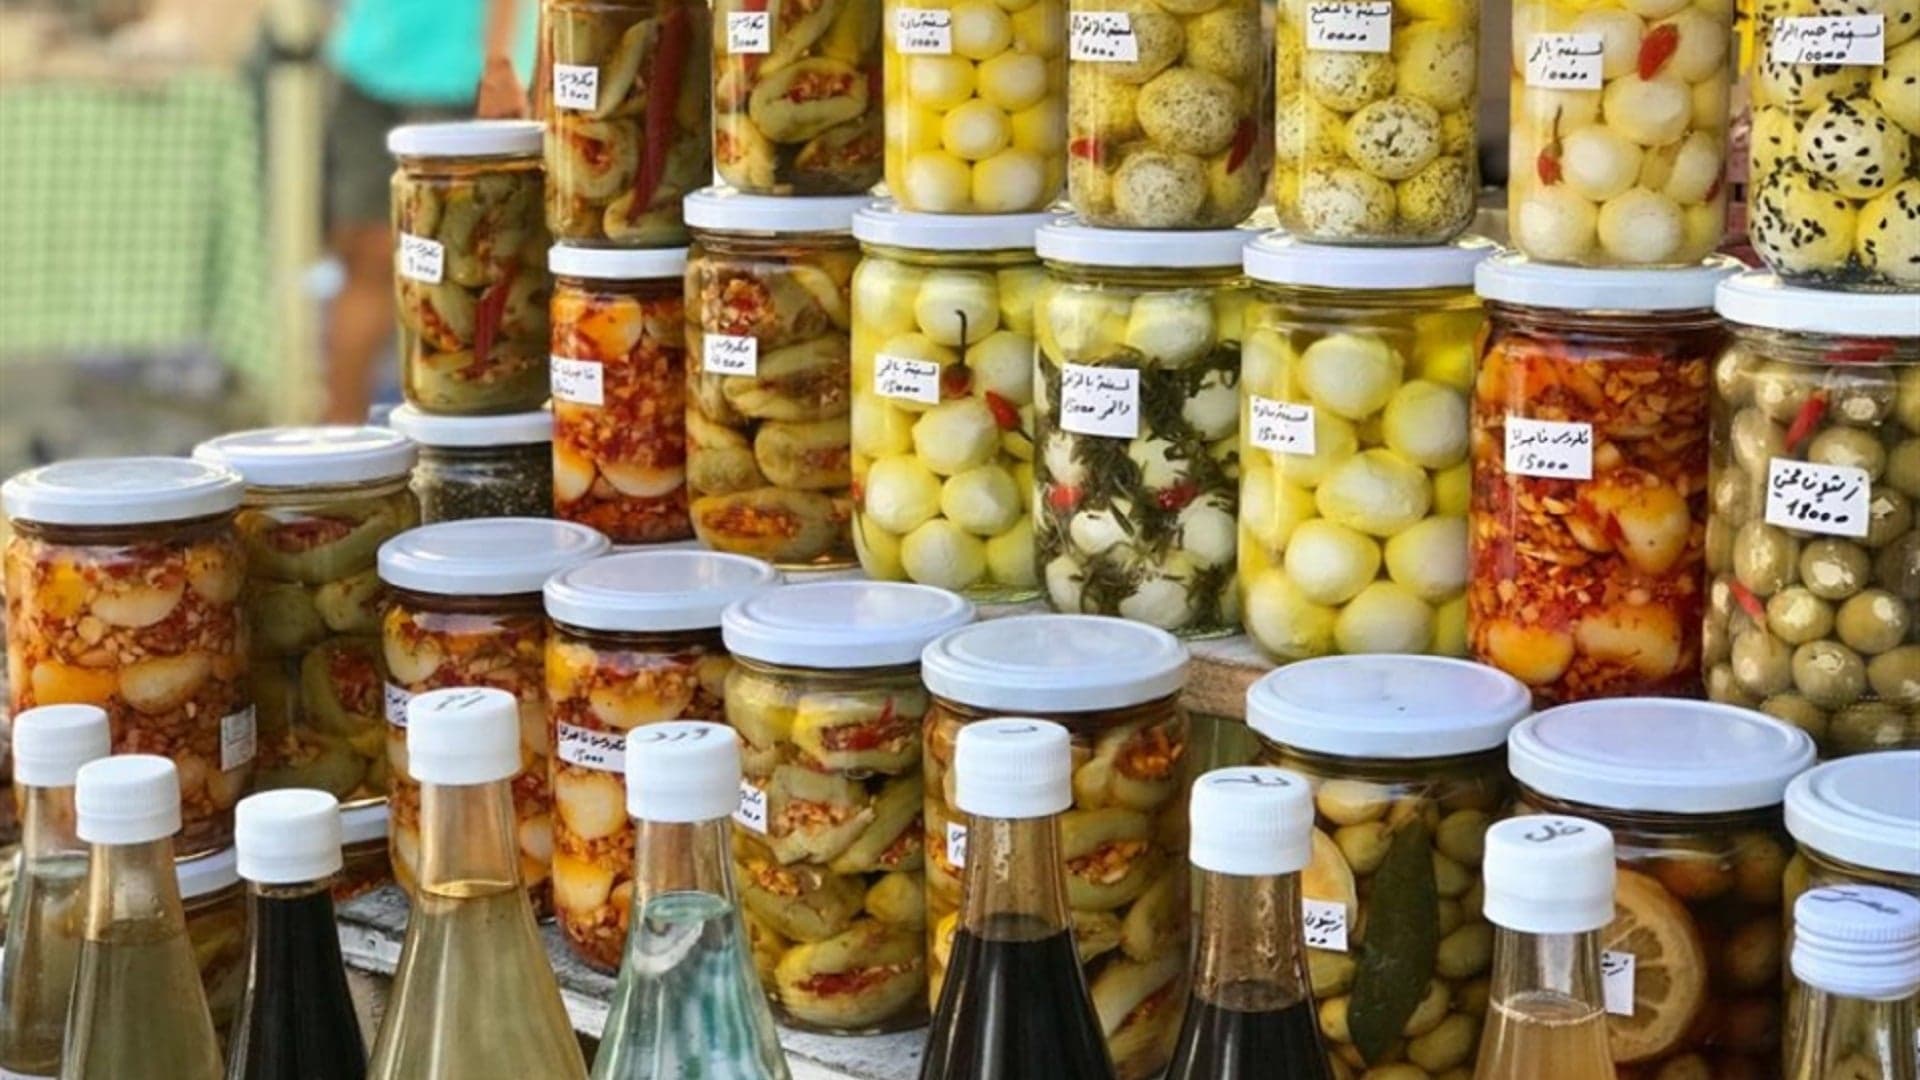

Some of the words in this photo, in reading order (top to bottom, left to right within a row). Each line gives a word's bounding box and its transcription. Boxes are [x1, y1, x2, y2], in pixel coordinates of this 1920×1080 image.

[1320, 27, 1366, 41] 10000
[1079, 39, 1114, 57] 10000
[1797, 47, 1846, 61] 10000
[1542, 64, 1587, 79] 10000
[883, 380, 919, 393] 15000
[1258, 426, 1295, 442] 15000
[1517, 453, 1568, 470] 15000
[1802, 472, 1863, 503] زيتون
[1786, 499, 1849, 523] 18000
